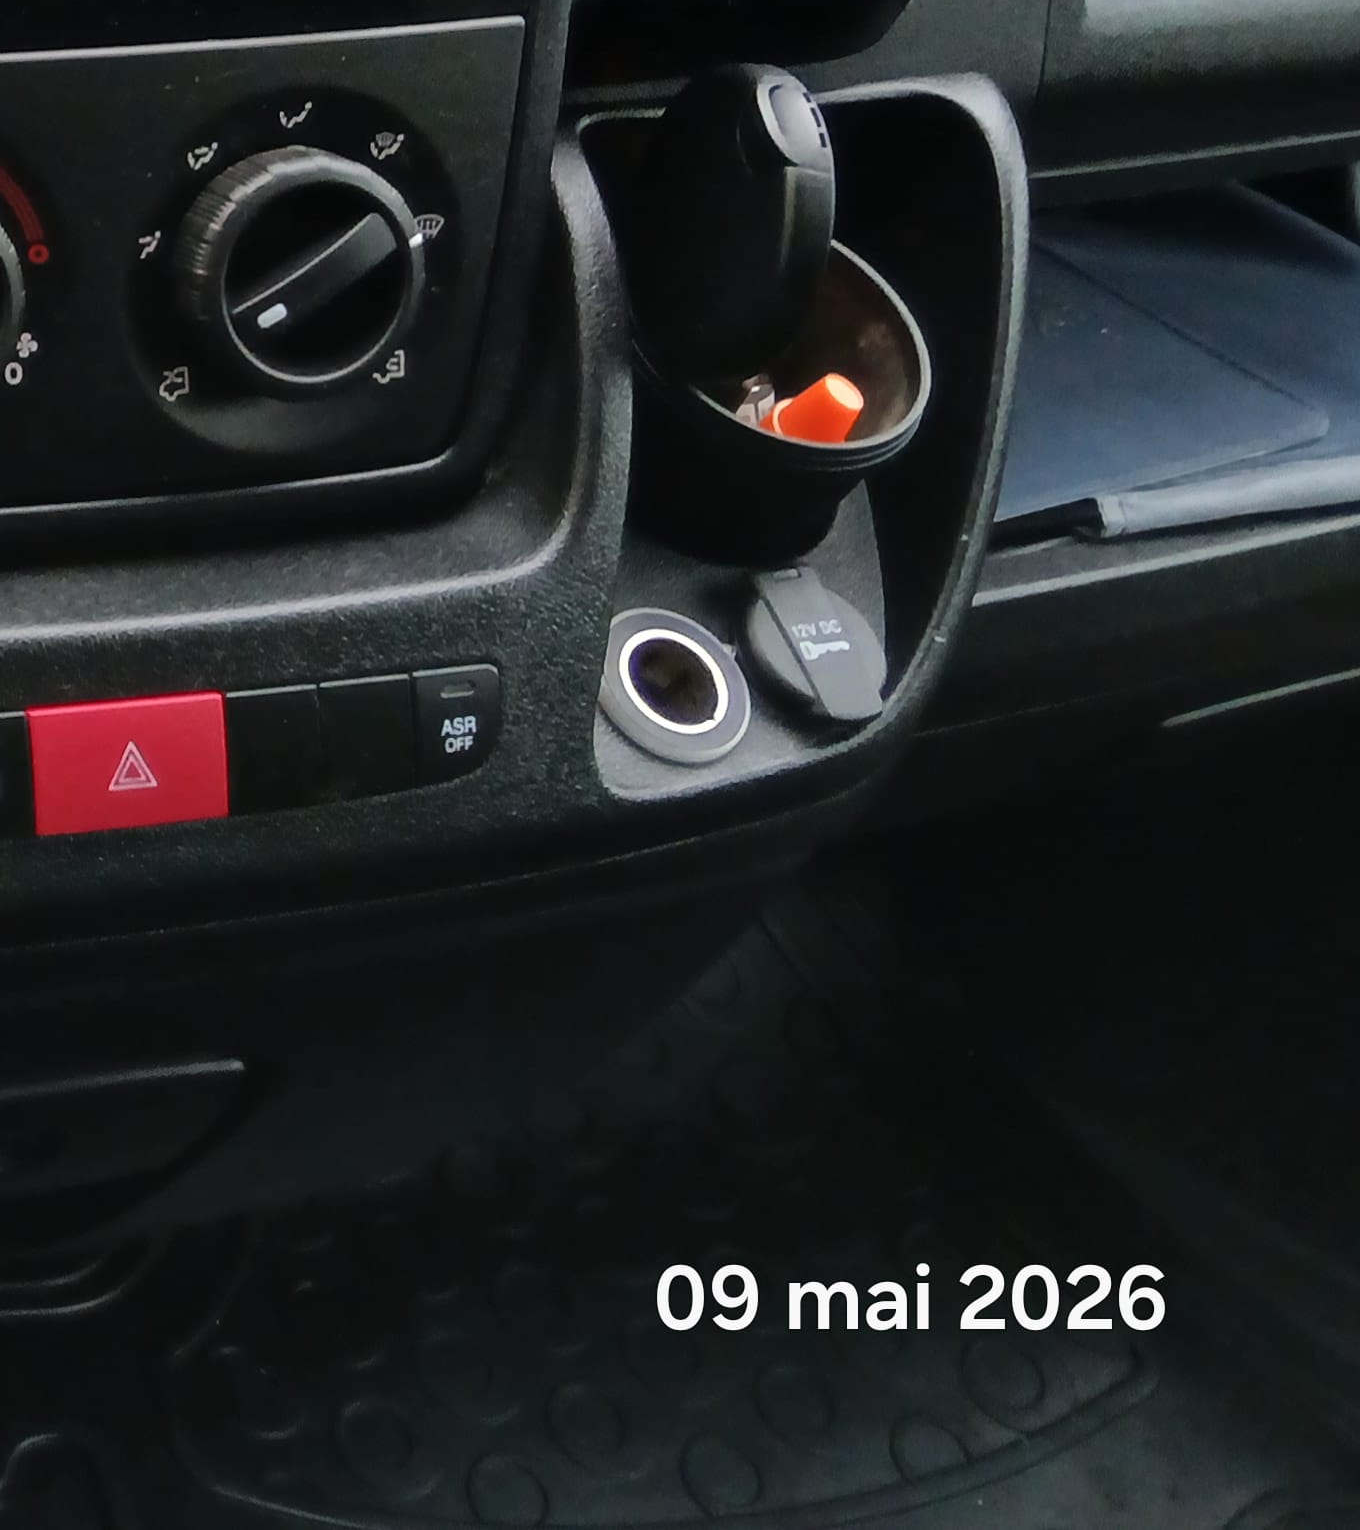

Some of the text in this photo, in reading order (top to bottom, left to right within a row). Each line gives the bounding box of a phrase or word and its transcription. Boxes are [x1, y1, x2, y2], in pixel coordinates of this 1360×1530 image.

[4, 361, 23, 386] 0
[791, 619, 842, 639] 12V DC
[440, 715, 477, 737] ASR
[445, 735, 474, 753] OFF
